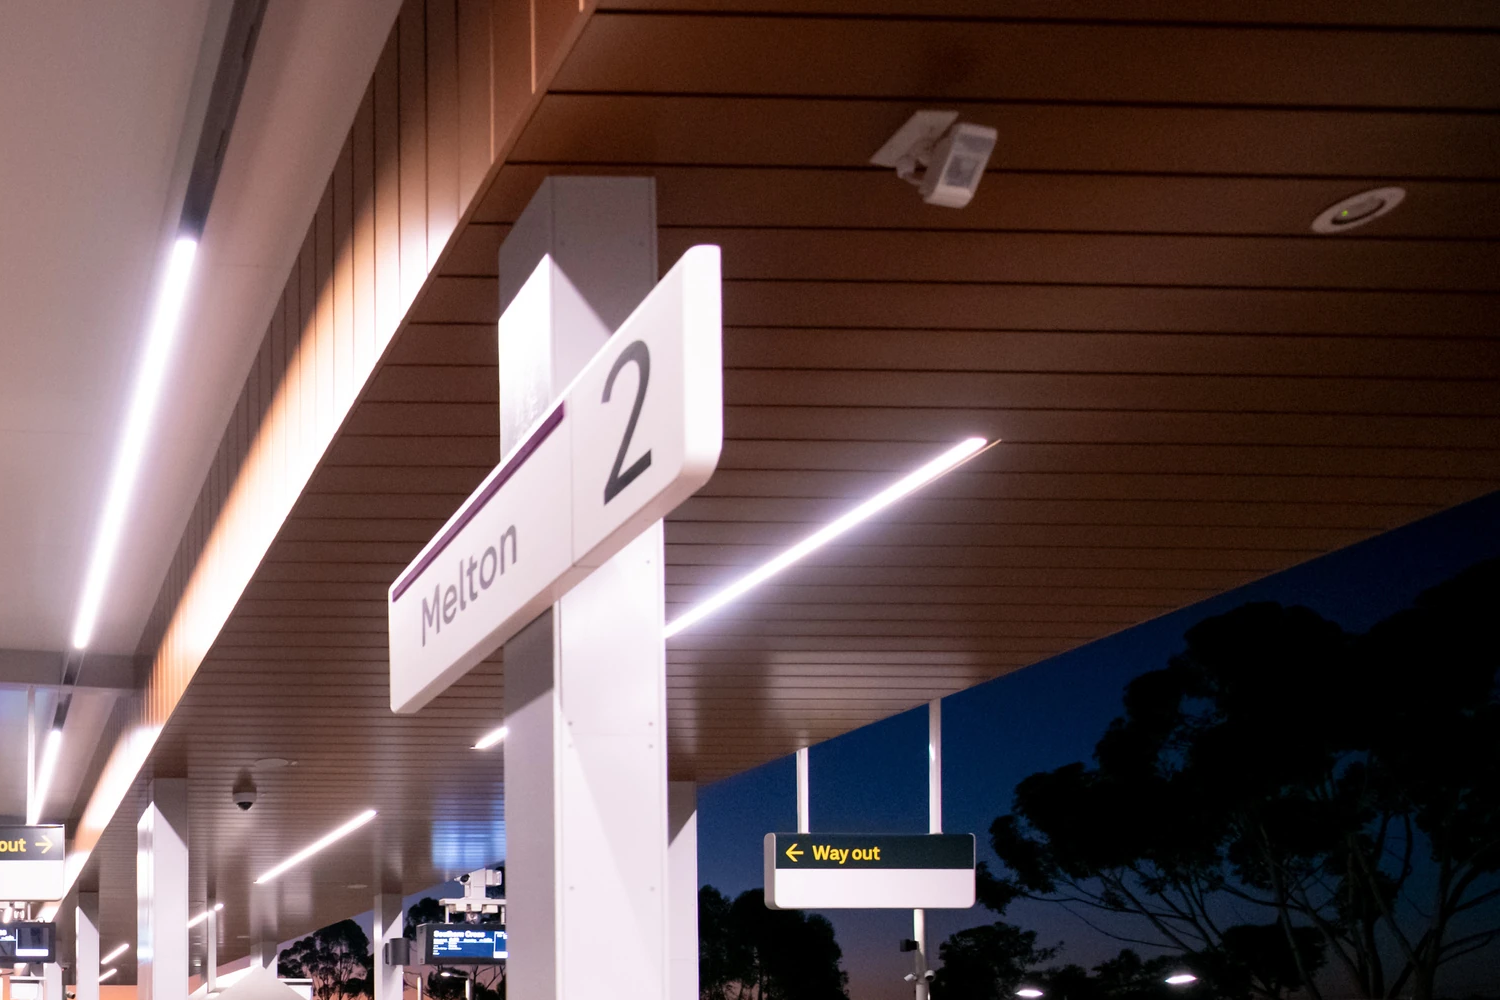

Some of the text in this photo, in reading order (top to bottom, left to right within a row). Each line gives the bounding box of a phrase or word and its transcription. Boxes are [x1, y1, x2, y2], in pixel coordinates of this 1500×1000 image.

[421, 340, 652, 647] Melton 2
[812, 845, 881, 865] Way out
